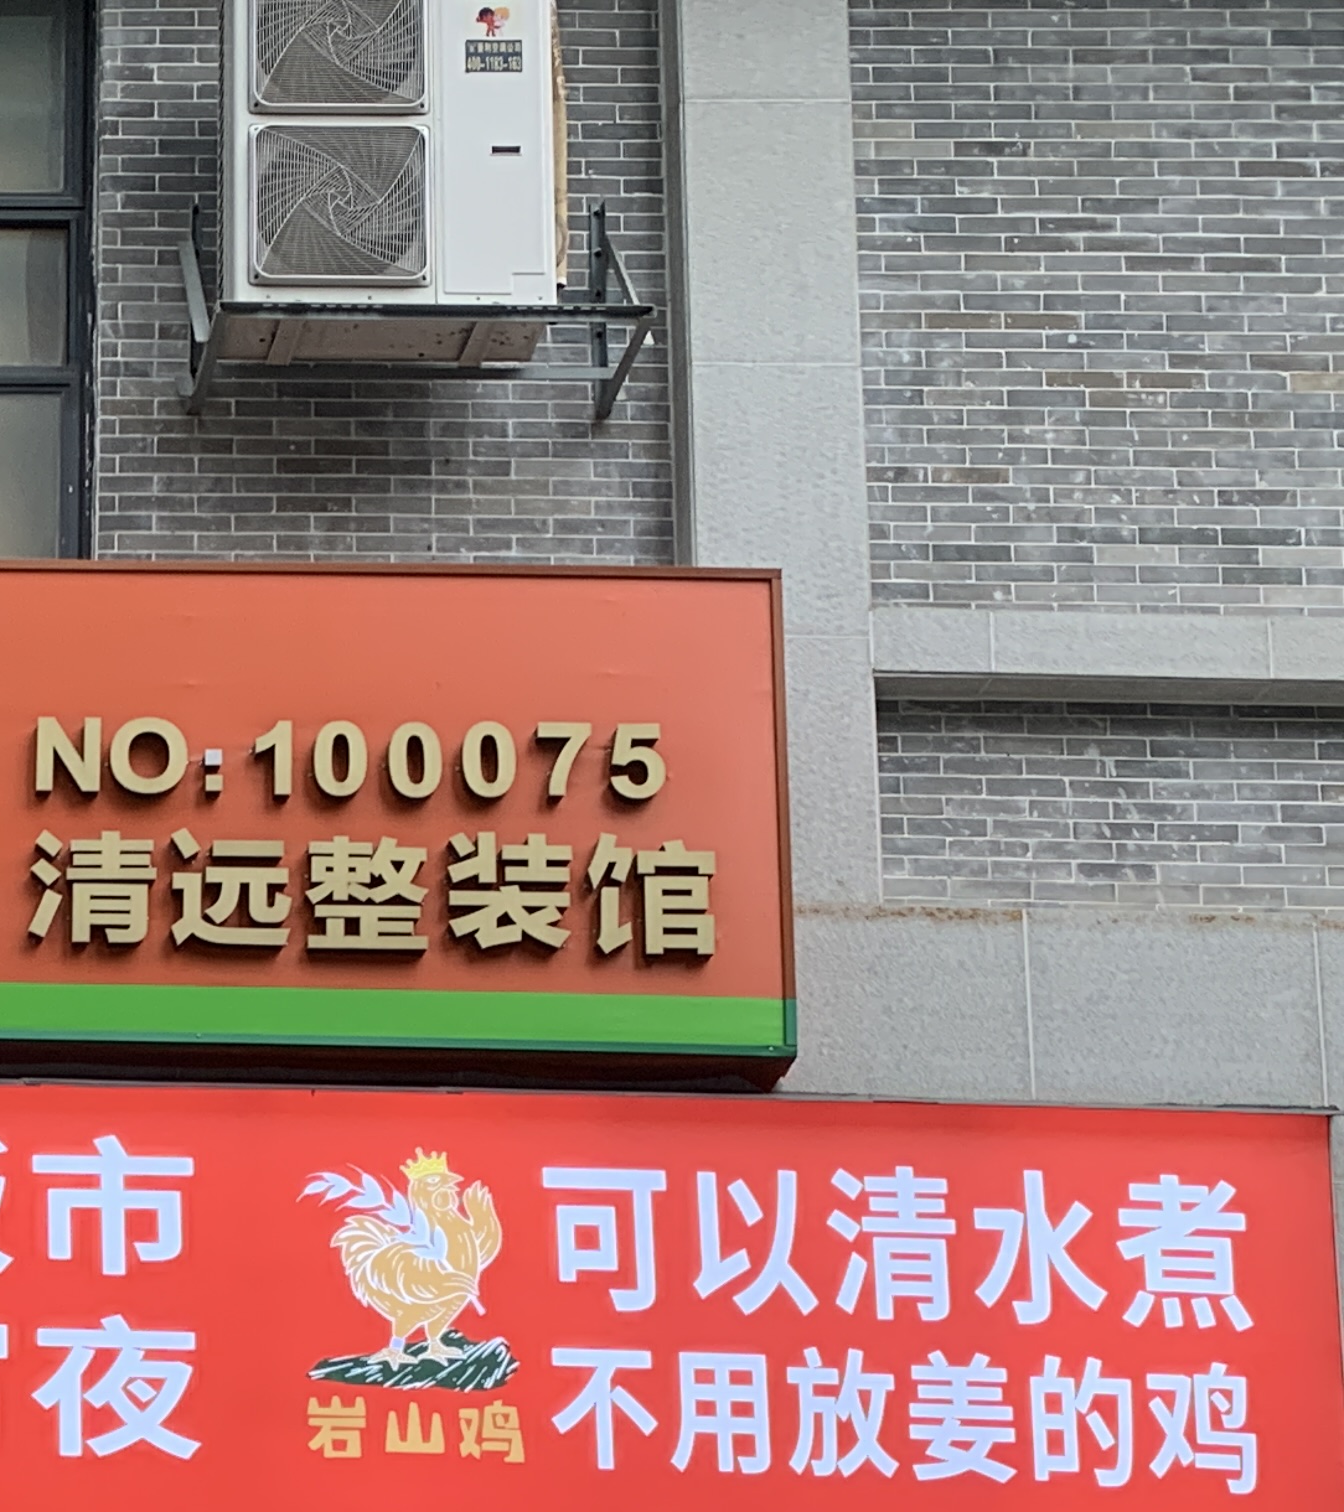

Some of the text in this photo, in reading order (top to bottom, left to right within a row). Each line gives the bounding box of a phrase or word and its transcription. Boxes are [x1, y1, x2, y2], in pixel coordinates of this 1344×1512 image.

[33, 716, 669, 803] NO:100075
[26, 827, 716, 957] 清远整装馆
[540, 1165, 1256, 1332] 可以清水煮
[307, 1396, 525, 1463] 岩山鸡
[551, 1344, 1258, 1495] 不用放姜的鸡
